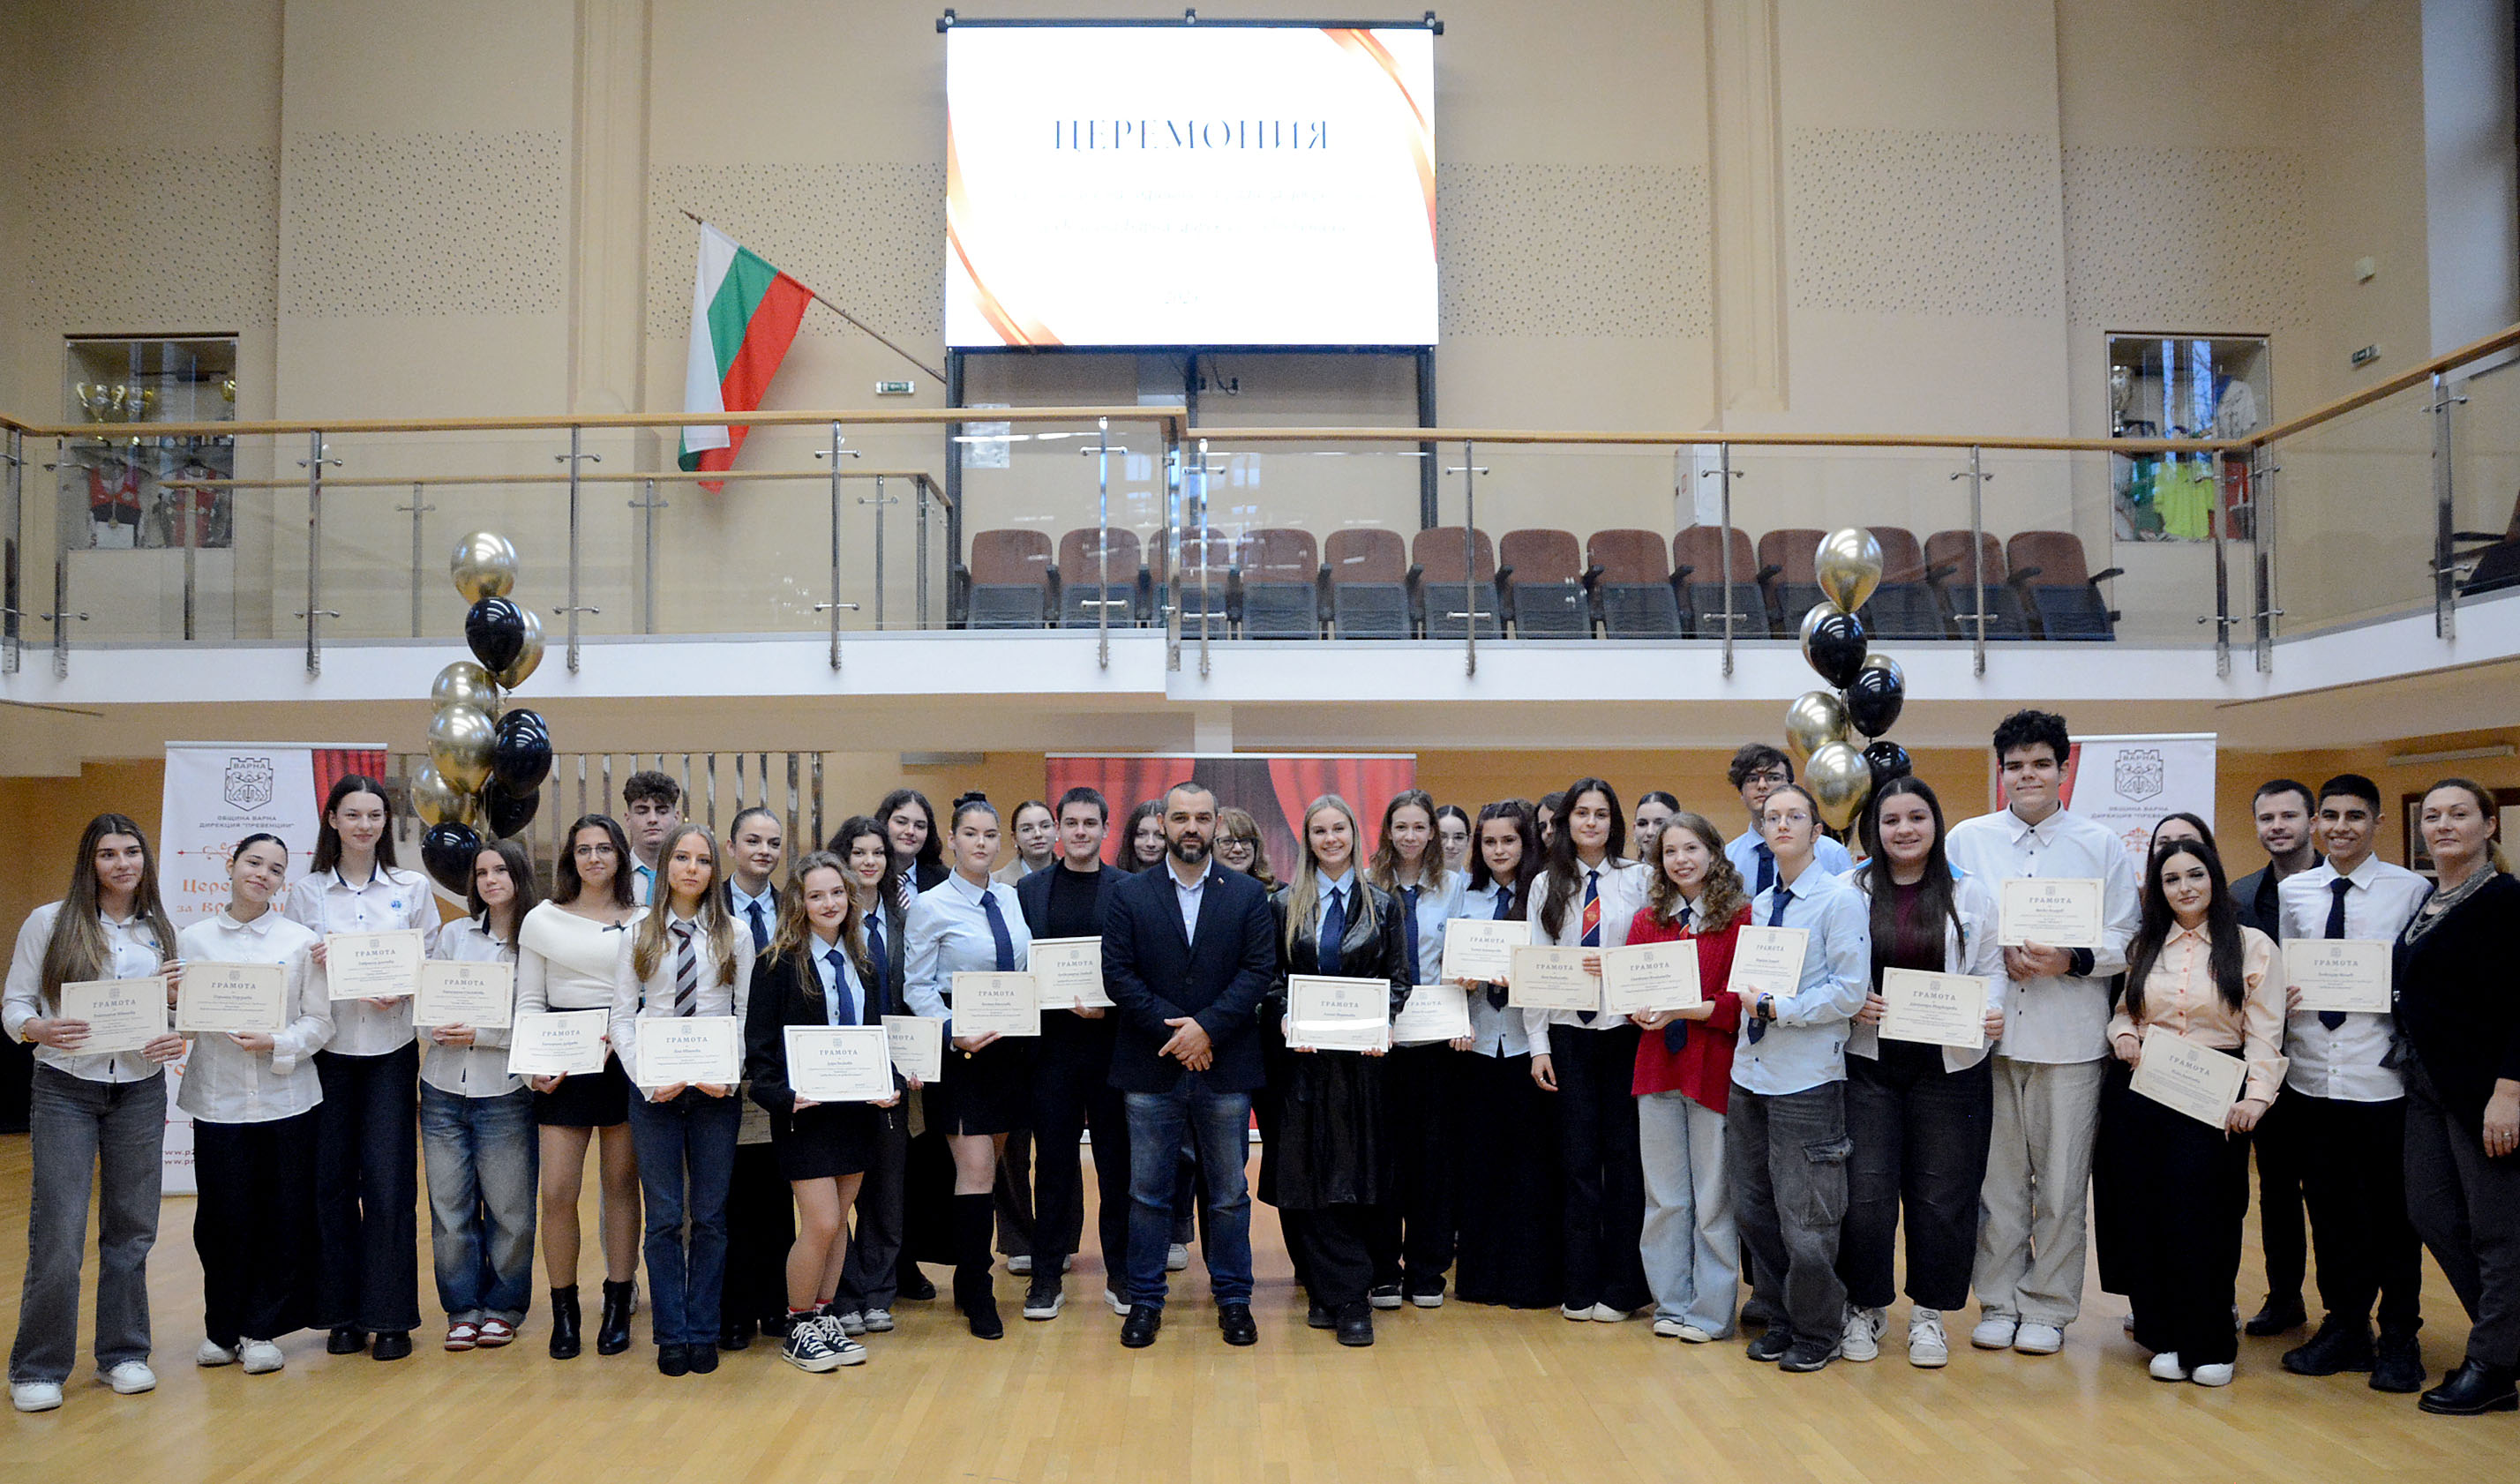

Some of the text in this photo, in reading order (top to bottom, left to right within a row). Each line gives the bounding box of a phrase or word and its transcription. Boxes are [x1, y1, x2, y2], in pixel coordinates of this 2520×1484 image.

[1056, 120, 1327, 153] ЦЕРЕМОНИЯ
[355, 948, 396, 957] ГРАМОТА
[1630, 963, 1670, 971] ГРАМОТА
[1913, 991, 1956, 1001] ГРАМОТА
[93, 999, 137, 1008] ГРАМОТА
[2169, 1054, 2210, 1076] ГРАМОТА
